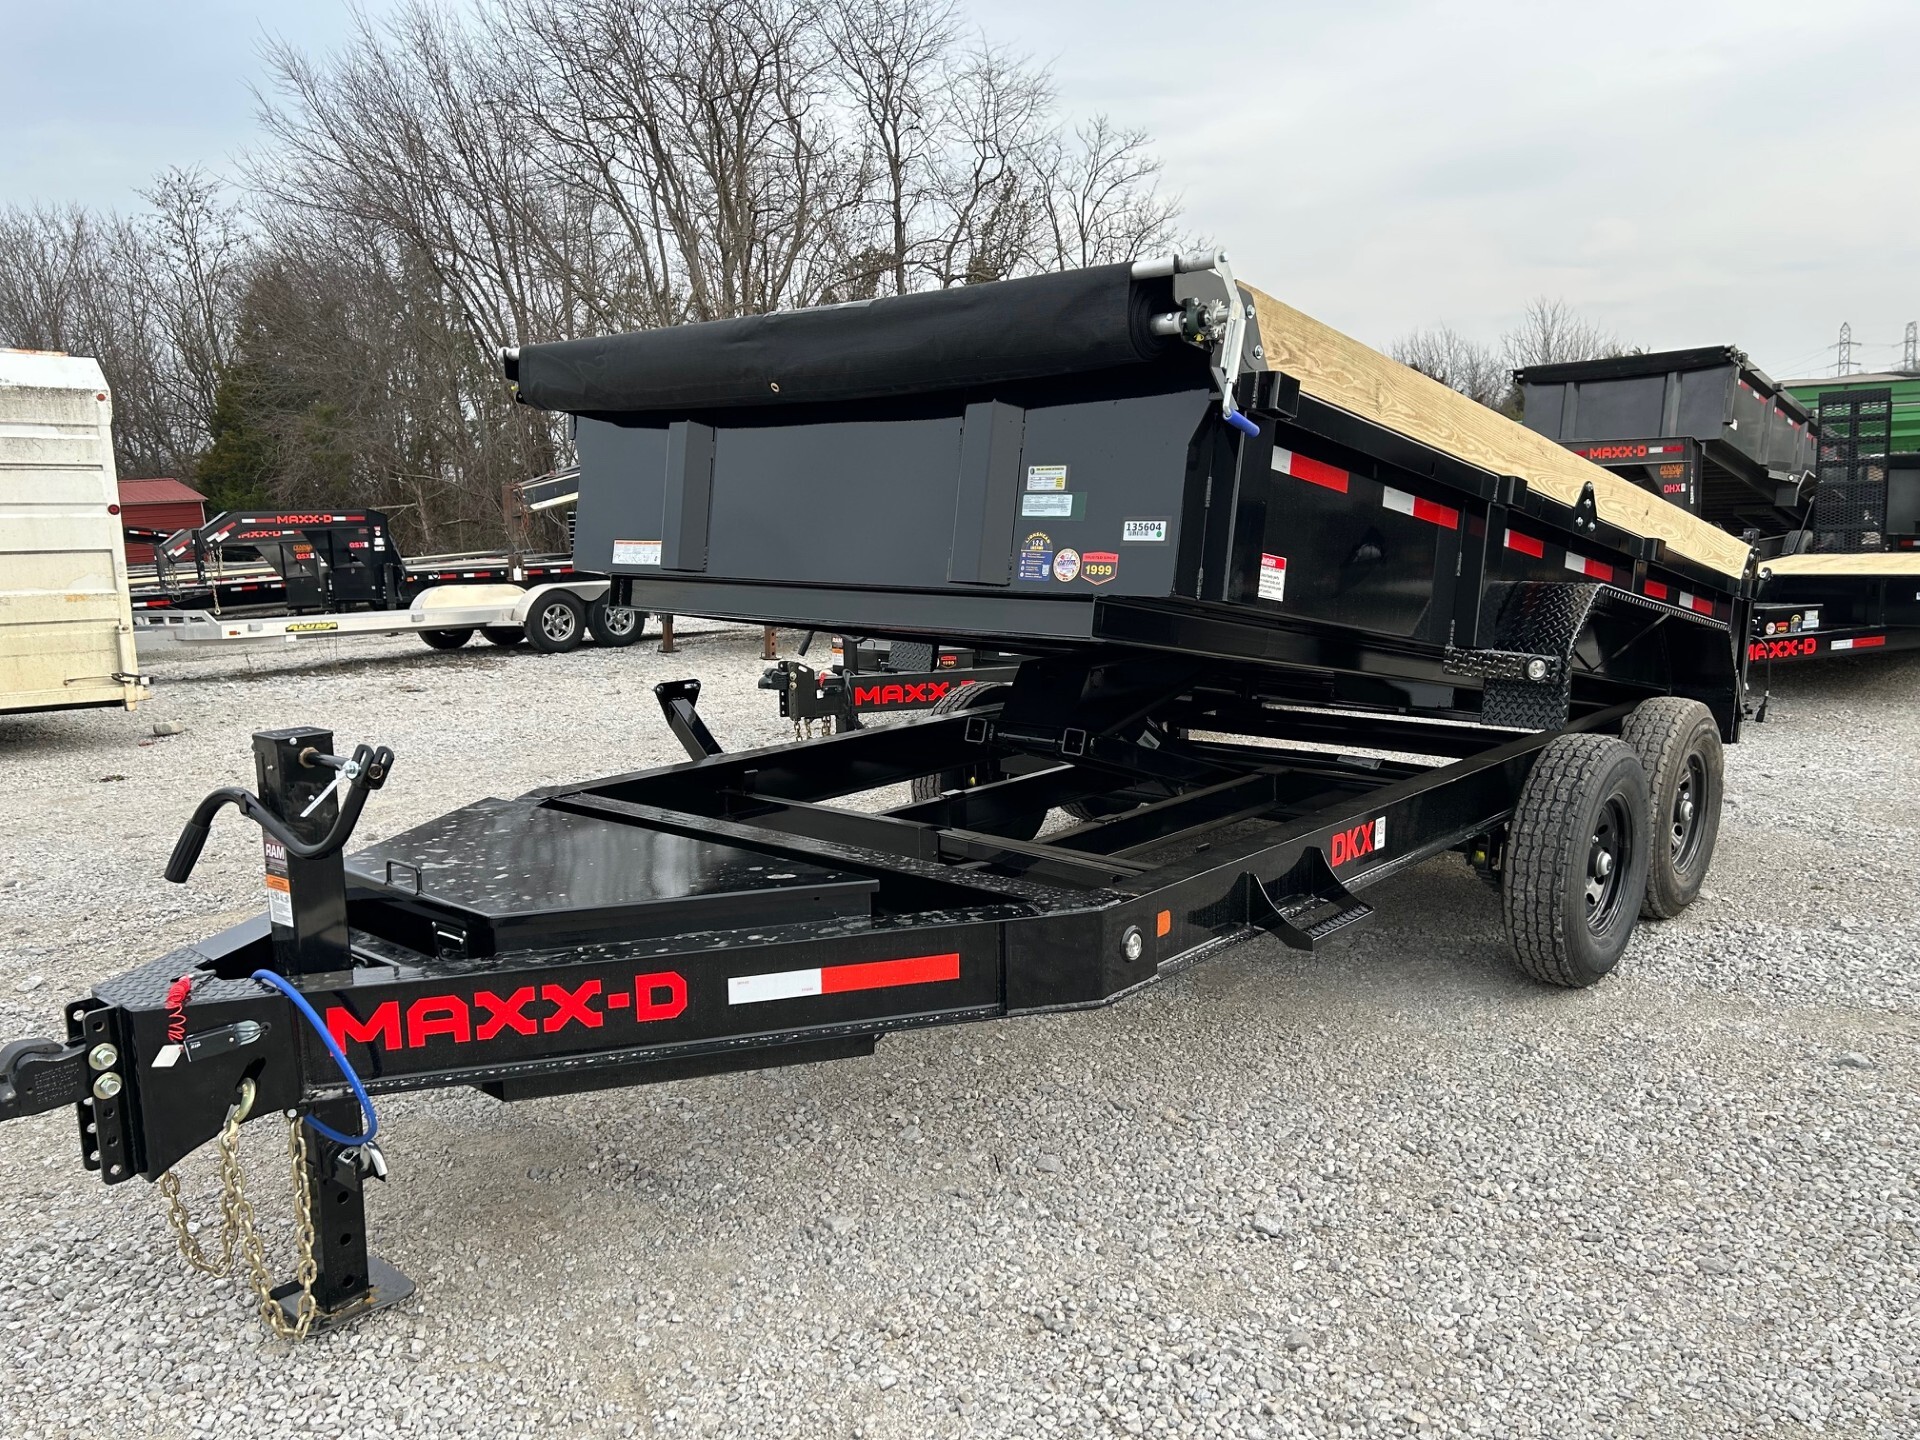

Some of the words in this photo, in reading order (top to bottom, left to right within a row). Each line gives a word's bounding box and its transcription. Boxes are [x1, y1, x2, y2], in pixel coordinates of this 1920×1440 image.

[1589, 445, 1647, 459] MAXX-D
[1663, 483, 1681, 493] DHX
[276, 514, 333, 524] MAXX-D
[1126, 523, 1162, 531] 135604
[238, 530, 281, 539] AXX-D
[1085, 564, 1112, 575] 1999
[286, 622, 338, 631] ALUMA
[854, 680, 976, 706] MAXX-
[1331, 821, 1374, 867] DKX
[265, 843, 285, 860] RAM
[326, 971, 688, 1057] MAXX-D
